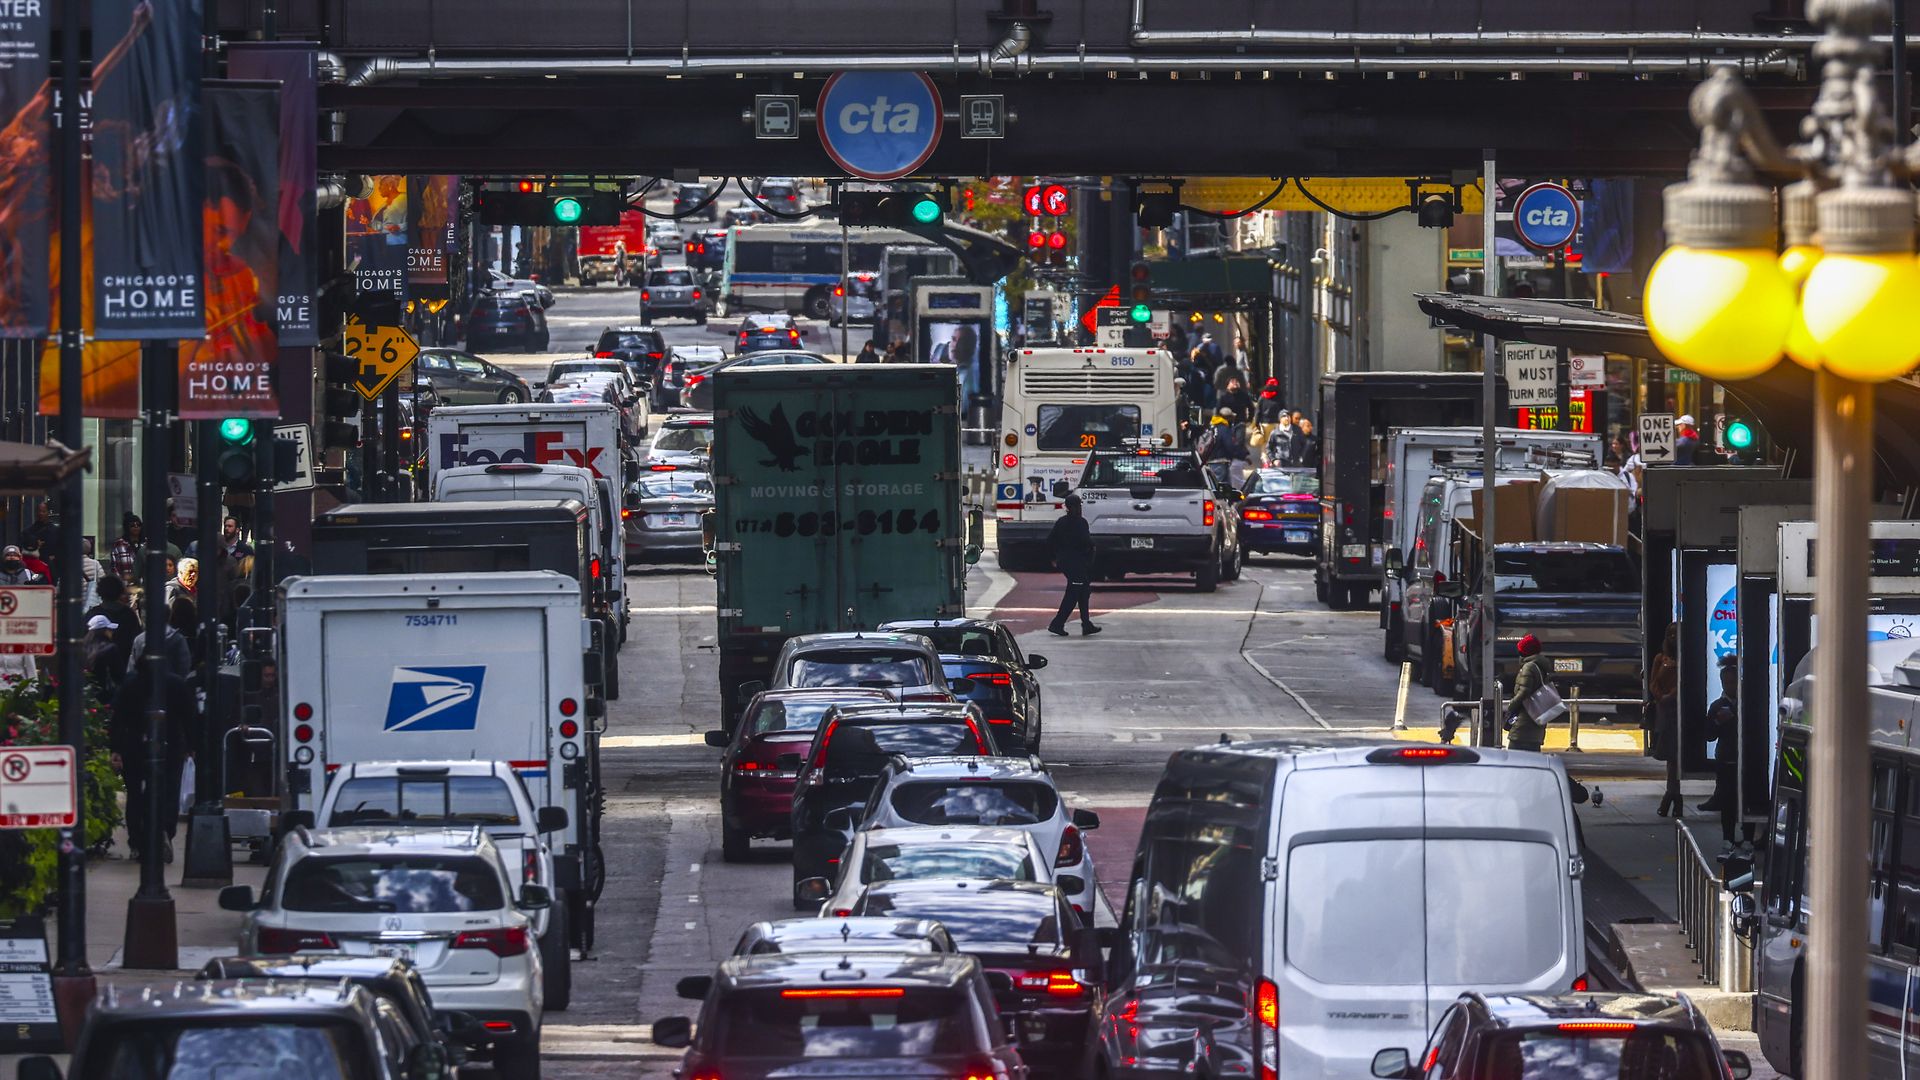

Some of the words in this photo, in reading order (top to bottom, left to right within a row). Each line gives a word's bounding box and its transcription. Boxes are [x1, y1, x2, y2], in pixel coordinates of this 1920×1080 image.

[839, 95, 920, 134] cta
[1526, 205, 1569, 226] cta
[103, 274, 195, 287] CHICAGO'S
[105, 289, 195, 318] HOME
[1111, 357, 1135, 366] 8150
[1507, 350, 1536, 361] RIGHT
[189, 362, 270, 372] CHICAGO'S
[1518, 367, 1555, 381] MUST
[189, 374, 270, 399] HOME
[1509, 388, 1534, 400] TURN
[796, 410, 933, 438] GOLDEN
[1642, 418, 1671, 431] ONE
[1080, 434, 1097, 448] 20
[1642, 431, 1671, 444] WAY
[440, 432, 604, 478] FedEx
[813, 439, 921, 466] EAGLE
[750, 485, 819, 498] MOVING
[844, 483, 924, 496] STORAGE
[405, 615, 457, 626] 7534711
[1327, 1011, 1390, 1019] TRANSIT
